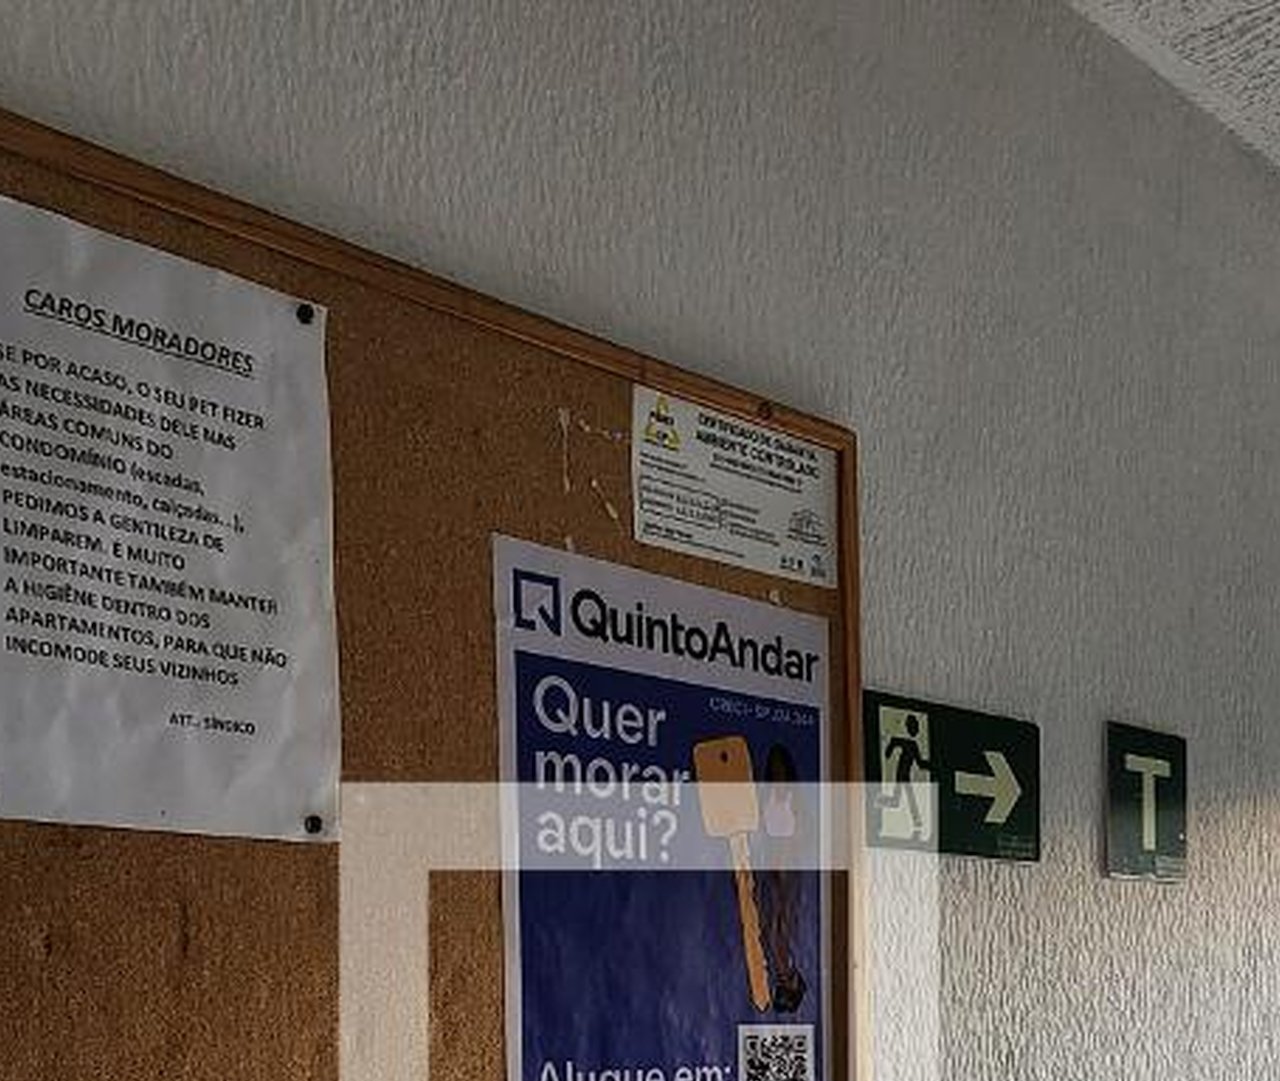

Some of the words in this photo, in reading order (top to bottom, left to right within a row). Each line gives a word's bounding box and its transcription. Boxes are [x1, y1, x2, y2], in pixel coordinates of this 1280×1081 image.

[24, 290, 104, 331] CAROS
[112, 315, 252, 372] MORADORES
[22, 350, 60, 373] POR
[137, 382, 150, 397] O
[155, 387, 184, 408] SEU
[189, 397, 217, 416] PET
[223, 406, 263, 428] FIZER
[25, 382, 155, 427] NECESSIDADES
[160, 417, 198, 439] DELE
[63, 419, 142, 451] COMUNS
[147, 440, 172, 459] DO
[2, 490, 88, 521] PEDIMOS
[92, 510, 105, 524] A
[110, 514, 198, 545] GENTILEZA
[203, 534, 224, 551] DE
[3, 547, 123, 586] IMPORTANTE
[129, 573, 204, 601] TAMBÉM
[209, 589, 277, 613] MANTER
[127, 546, 184, 570] MUITO
[4, 578, 17, 593] A
[102, 596, 170, 621] DENTRO
[177, 610, 210, 628] DOS
[6, 636, 108, 667] INCOMODE
[113, 654, 154, 673] SEUS
[160, 662, 238, 685] VIZINHOS
[164, 636, 208, 655] PARA
[212, 643, 248, 662] QUE
[252, 648, 286, 667] NÃO
[571, 589, 818, 682] QuintoAndar
[534, 675, 667, 746] Quer
[535, 750, 690, 807] morar
[1125, 753, 1170, 850] T
[536, 807, 677, 868] aqui?
